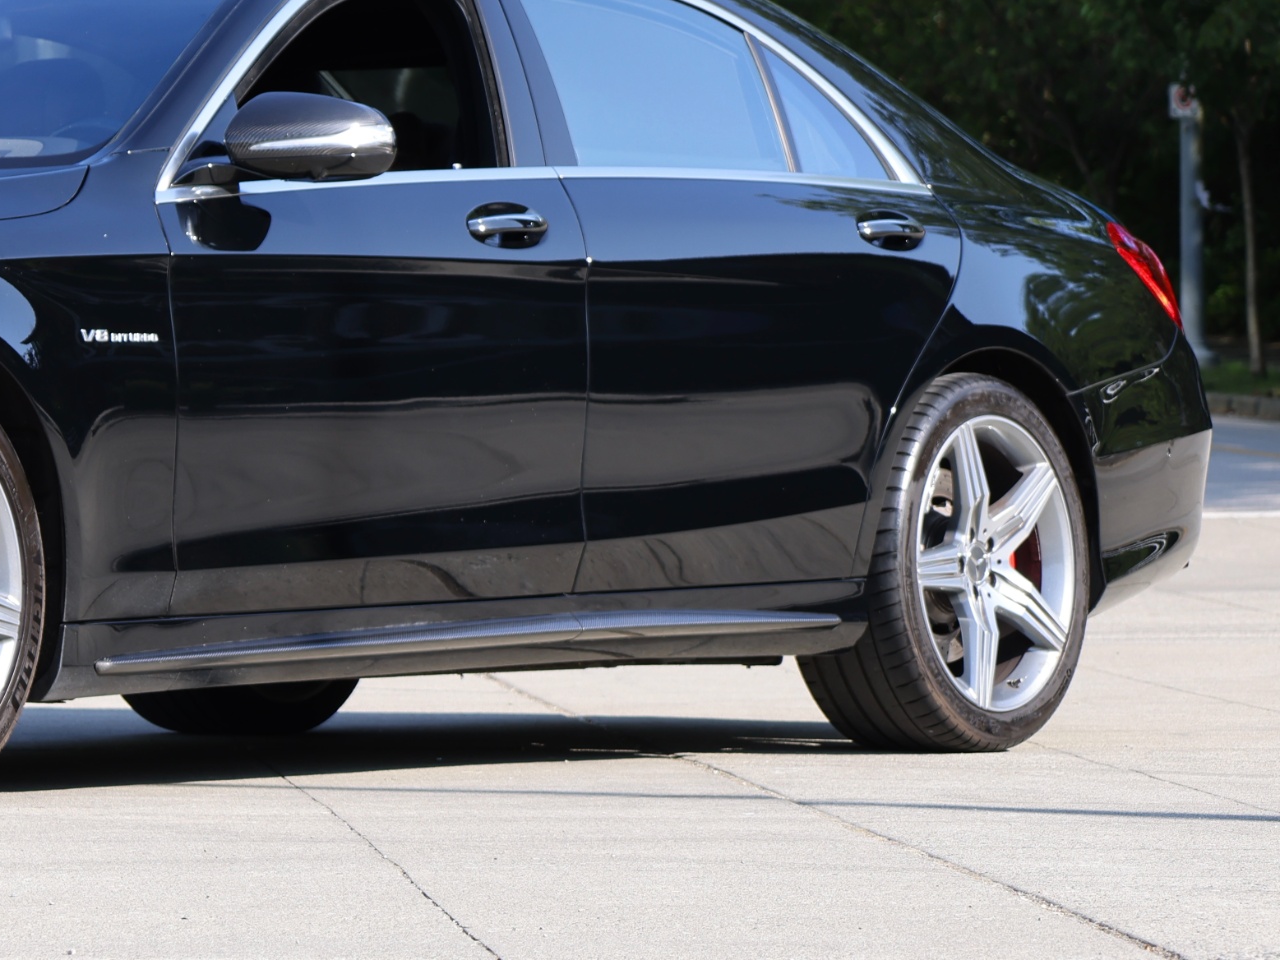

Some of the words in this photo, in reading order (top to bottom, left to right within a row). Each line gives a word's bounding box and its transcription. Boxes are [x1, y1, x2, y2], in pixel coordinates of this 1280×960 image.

[80, 328, 109, 342] V8
[111, 332, 159, 342] BITURBO
[11, 562, 43, 711] MICHELIN
